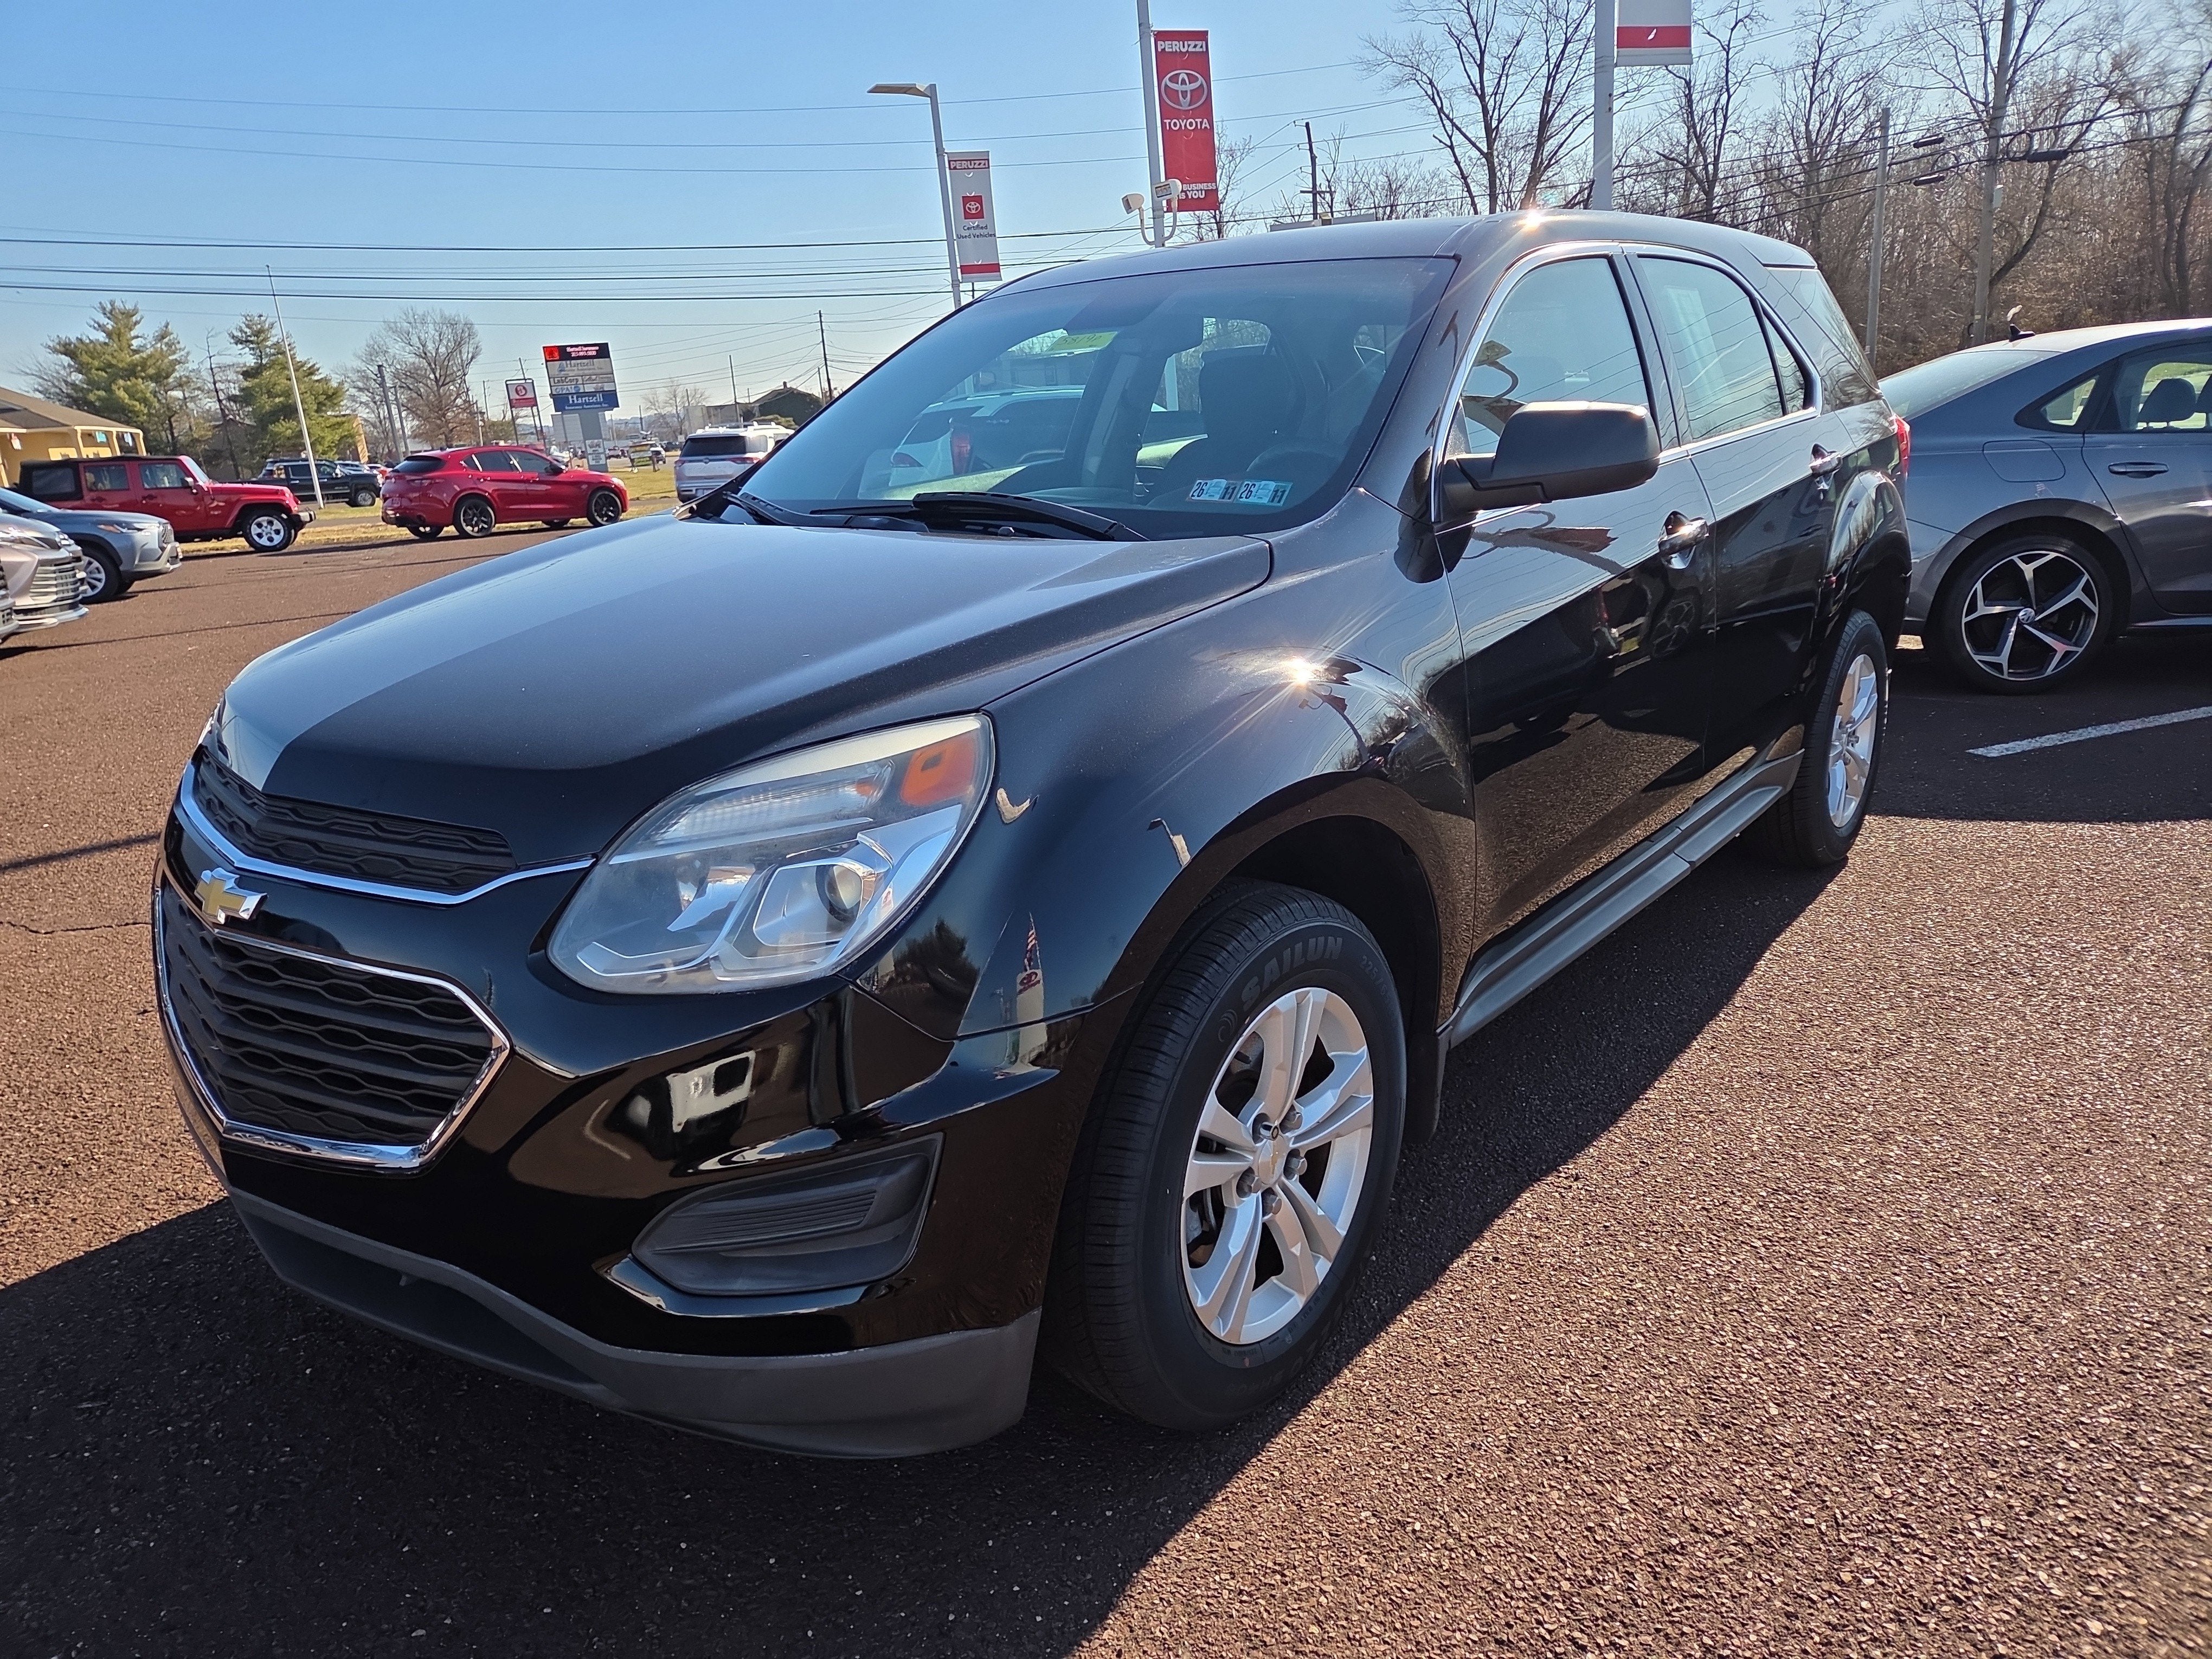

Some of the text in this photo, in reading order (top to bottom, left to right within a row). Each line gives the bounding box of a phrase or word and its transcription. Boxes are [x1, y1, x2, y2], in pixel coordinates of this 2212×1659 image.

[1157, 41, 1206, 52] PERUZZI
[1163, 118, 1210, 130] TOYOTA
[950, 160, 988, 169] PERUZZI
[1182, 183, 1217, 191] BUSINESS
[1186, 190, 1205, 199] YOU
[1191, 481, 1287, 503] 26 11 26 11
[1241, 936, 1343, 1012] SAILUN
